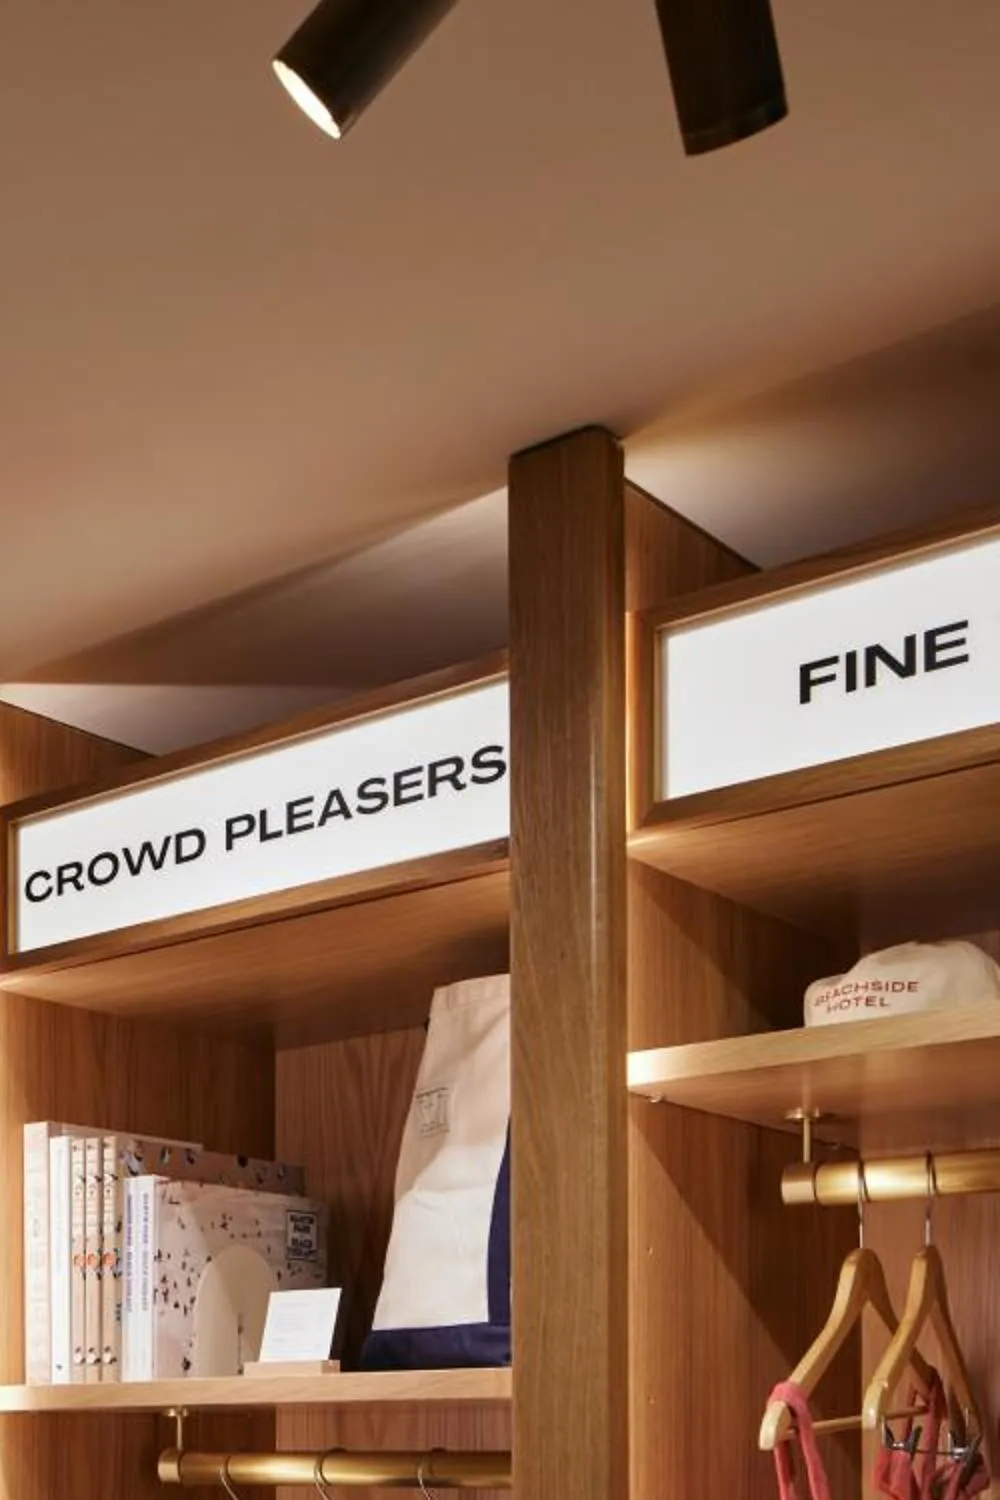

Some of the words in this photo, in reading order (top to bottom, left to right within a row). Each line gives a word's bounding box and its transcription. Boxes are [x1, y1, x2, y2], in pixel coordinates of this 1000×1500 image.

[799, 619, 969, 705] FINE
[24, 828, 206, 903] CROWD
[225, 745, 508, 852] PLEASERS
[814, 981, 920, 1007] BEACHSIDE
[827, 995, 889, 1013] HOTEL
